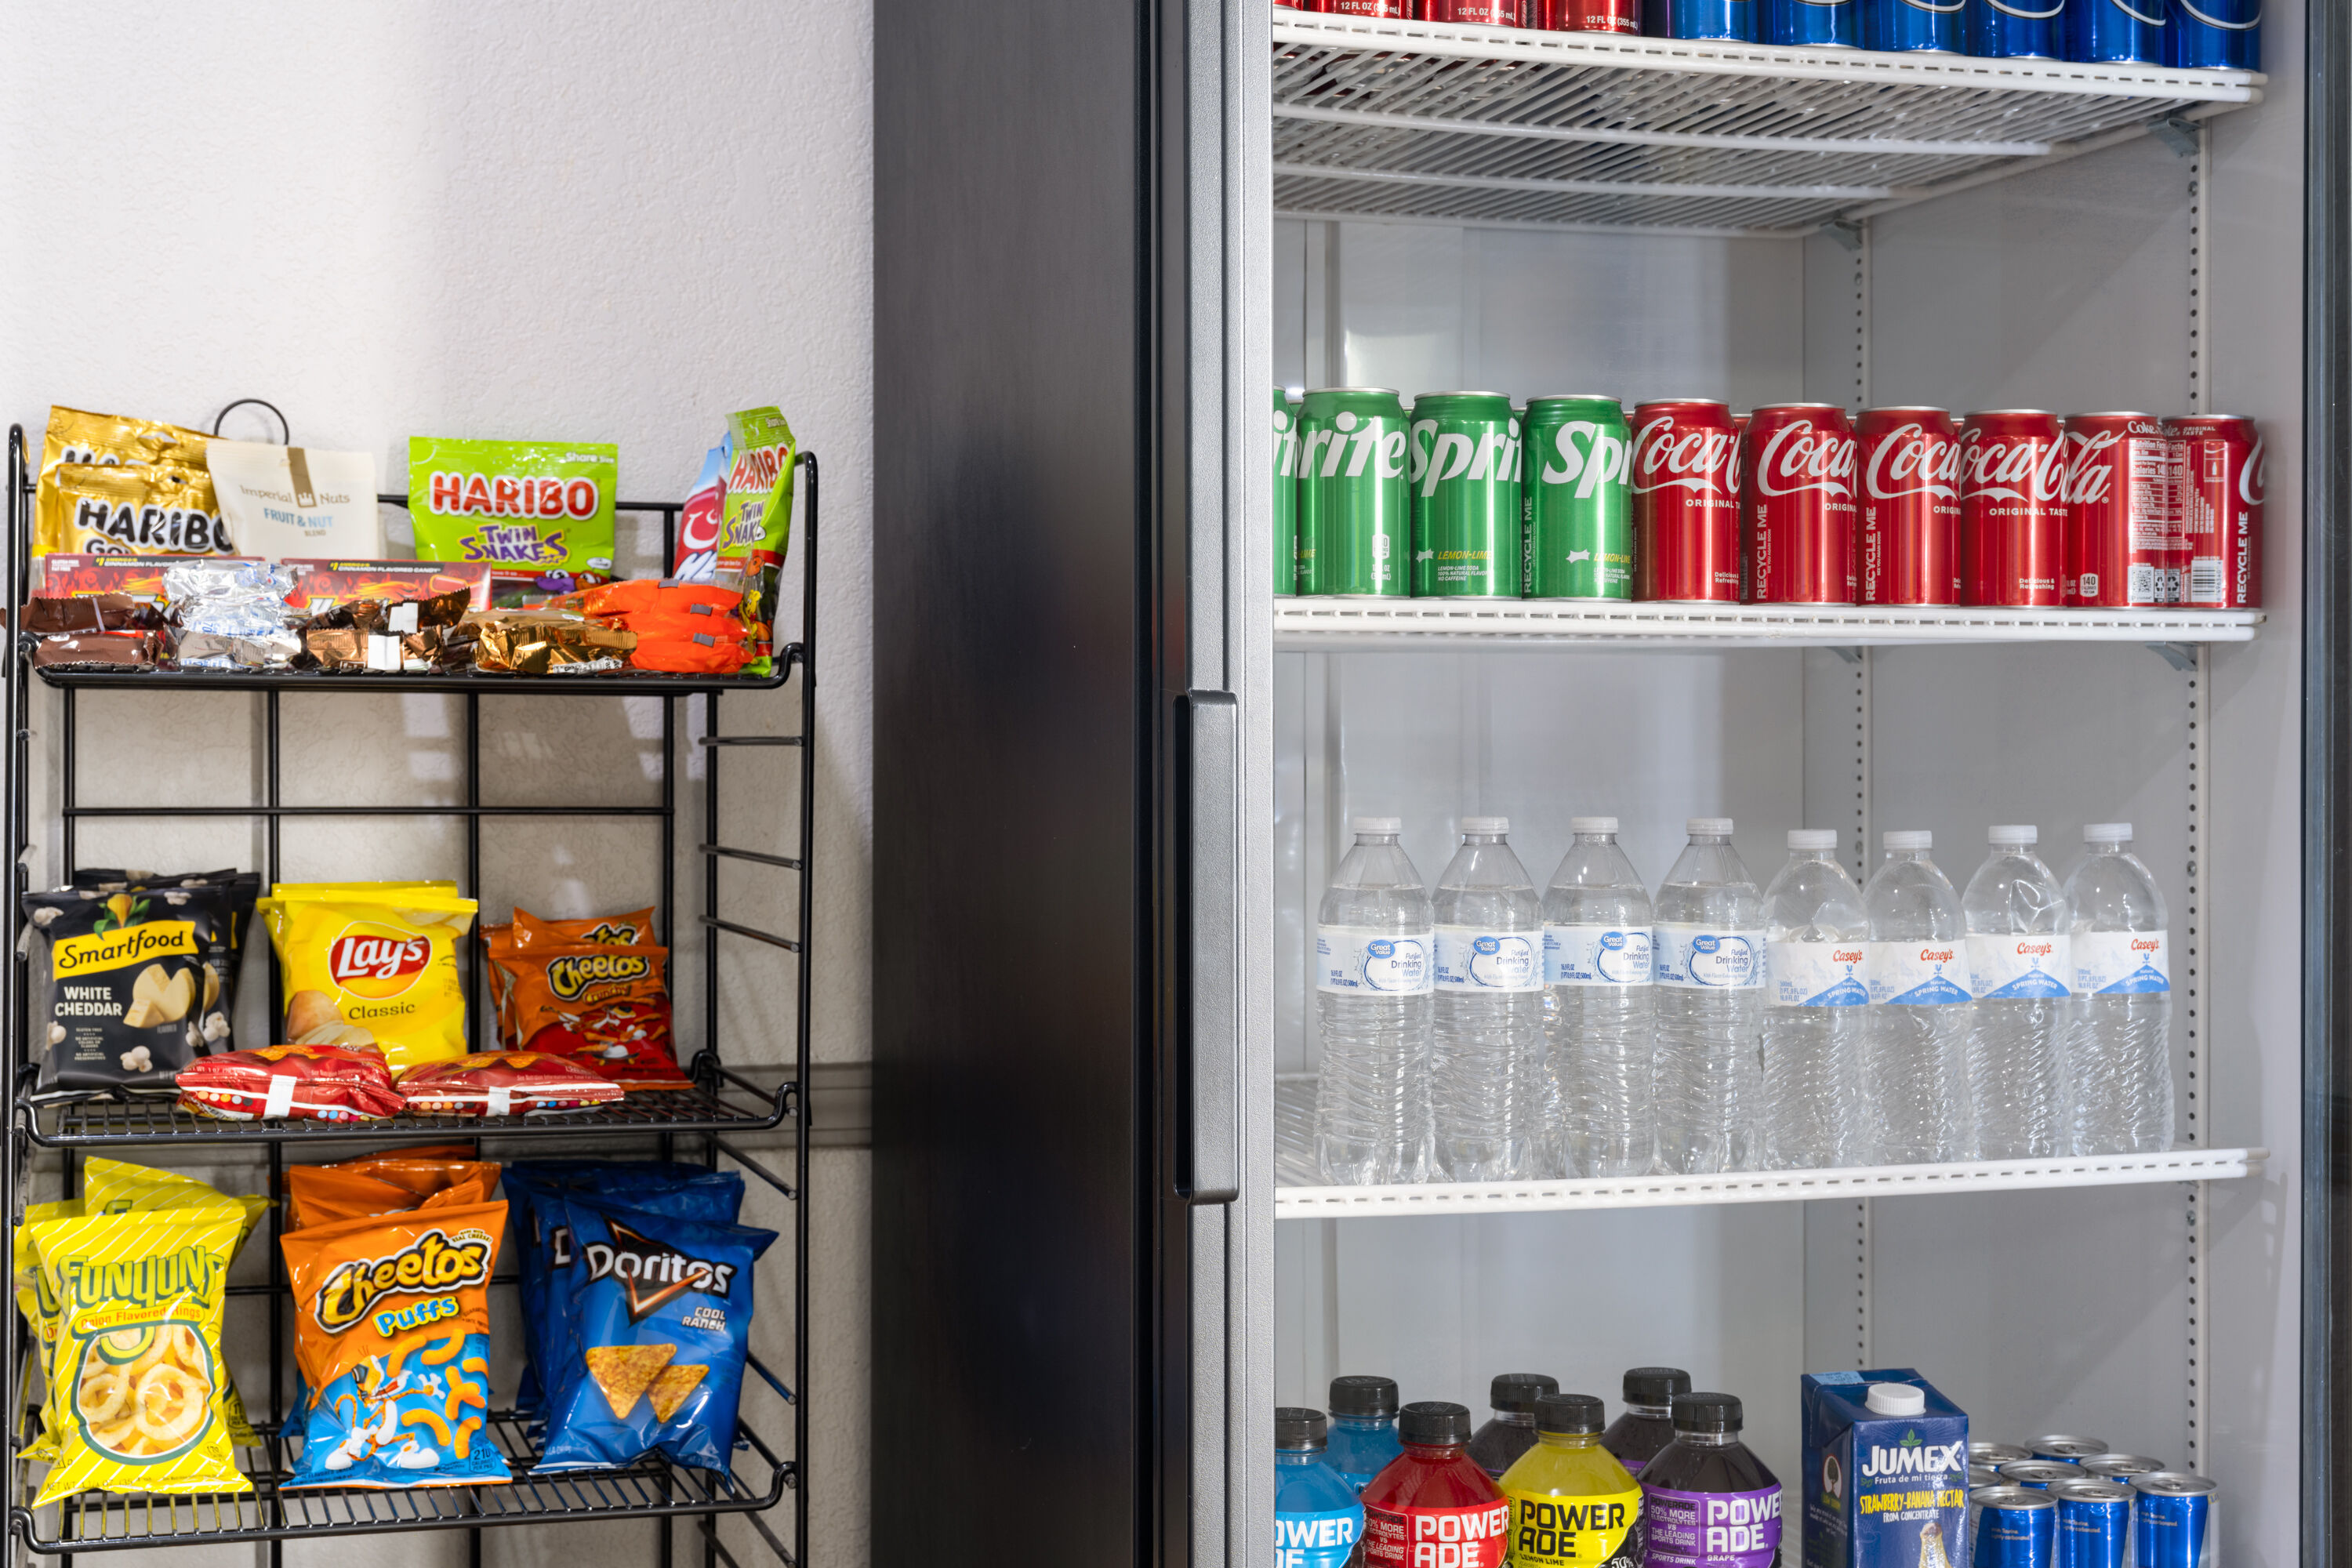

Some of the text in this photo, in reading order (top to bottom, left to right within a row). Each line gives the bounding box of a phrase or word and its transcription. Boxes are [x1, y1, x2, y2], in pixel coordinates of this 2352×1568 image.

[1341, 2, 1350, 10] 12
[1362, 2, 1372, 11] OZ
[1457, 7, 1489, 16] 12 FL OZ
[1586, 15, 1596, 24] 12
[1597, 16, 1606, 24] FL
[1617, 16, 1630, 27] (355
[1297, 411, 1406, 479] rite
[239, 485, 350, 505] Imperial Nuts
[430, 471, 598, 521] HARIBO
[1686, 499, 1734, 510] ORIGINAL
[1989, 507, 2068, 517] ORIGINAL TASTE
[263, 508, 333, 528] FRUIT & NUT
[477, 524, 539, 546] TWIN
[458, 531, 569, 566] SNAKES
[1523, 496, 1533, 593] RECYCLE ME
[1756, 504, 1768, 600] RECYCLE ME
[1437, 550, 1492, 560] LEMON-LIME
[1865, 506, 1876, 601] RECYCLE ME
[2237, 511, 2249, 604] RECYCLE ME
[2082, 576, 2096, 586] 140
[1475, 939, 1496, 948] Great
[1603, 935, 1624, 944] Great
[2130, 938, 2160, 953] Casey's
[58, 928, 185, 970] Smartfood
[1370, 943, 1392, 952] Great
[2016, 942, 2053, 956] Casey's
[336, 937, 425, 980] Lay's
[1496, 956, 1530, 967] Drinking
[1622, 951, 1650, 963] Drinking
[1715, 956, 1749, 967] Drinking
[1832, 949, 1864, 964] Casey's
[1920, 949, 1955, 964] Casey's
[1390, 959, 1422, 970] Drinking
[1632, 960, 1650, 970] Water
[1726, 964, 1748, 974] Water
[548, 954, 648, 1000] Cheetos
[1401, 968, 1422, 978] Water
[2012, 978, 2058, 991] SPRING WATER
[2125, 975, 2165, 987] SPRING WATER
[64, 986, 112, 1001] WHITE
[1827, 987, 1866, 1000] SPRING WATER
[1914, 985, 1958, 998] SPRING WATER
[54, 1001, 123, 1017] CHEDDAR
[348, 1001, 416, 1021] Classic
[586, 1243, 733, 1295] Doritos
[59, 1245, 225, 1319] FUNYUNS
[317, 1231, 488, 1330] Cheetos
[81, 1313, 113, 1331] Onion
[115, 1307, 167, 1325] Flavored
[375, 1296, 459, 1338] Puffs
[695, 1305, 726, 1320] COOL
[681, 1316, 726, 1331] RANCH
[1861, 1440, 1963, 1477] JUMEX
[1875, 1472, 1948, 1485] Fruta de mi tierra
[1650, 1496, 1697, 1512] POWERADE
[1707, 1490, 1781, 1526] POWE
[1860, 1488, 1965, 1515] STRAWBERRY-BANANA NECTAR
[1519, 1498, 1625, 1531] POWER
[1650, 1504, 1697, 1521] 50% MORE
[1883, 1508, 1940, 1523] FROM CONCENTRATE
[1380, 1521, 1405, 1534] MORE
[1415, 1504, 1509, 1542] POWER
[1650, 1534, 1697, 1547] SPORTS DRINK
[1651, 1526, 1696, 1541] THE LEADING
[1706, 1523, 1765, 1553] ADE
[1376, 1541, 1405, 1554] LEADING
[1518, 1526, 1577, 1558] ADE
[1385, 1551, 1405, 1561] DRINK
[1414, 1541, 1480, 1568] ADE
[1519, 1554, 1565, 1566] LEMON LIME
[1651, 1553, 1697, 1566] SPORTS DRINK
